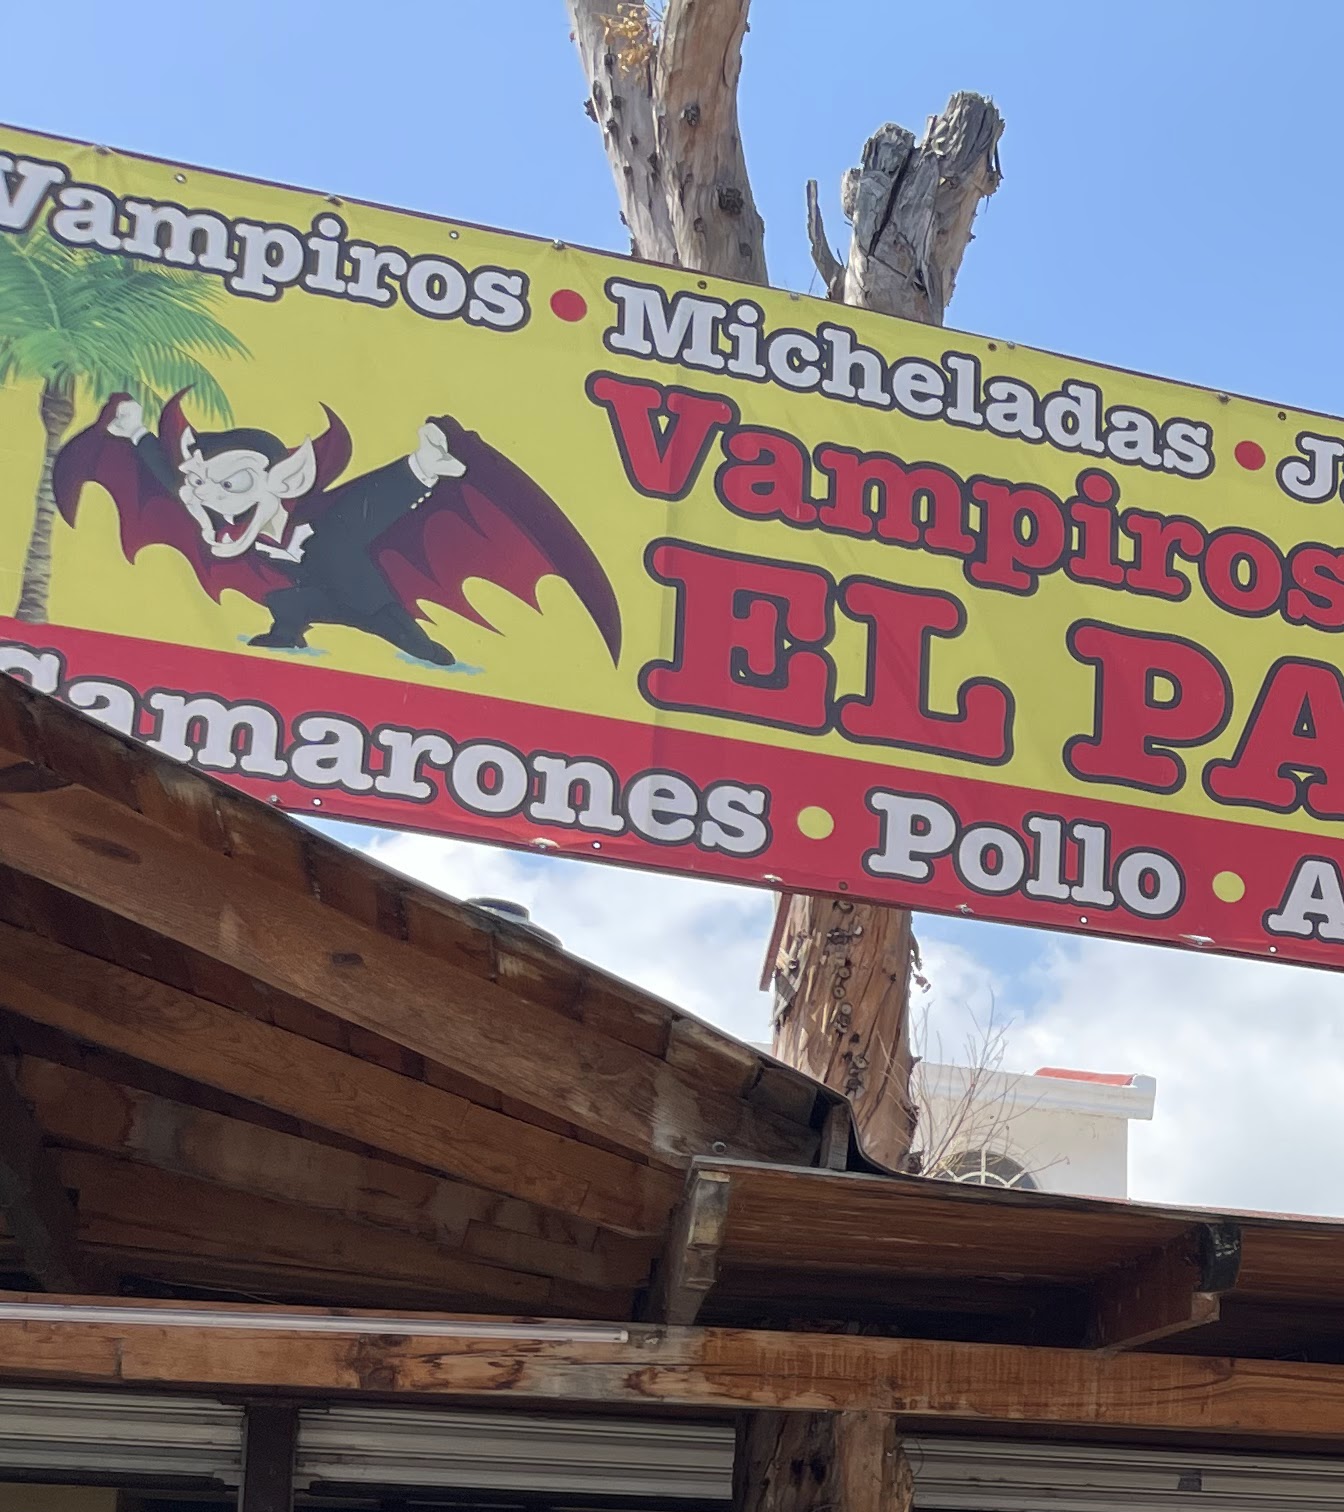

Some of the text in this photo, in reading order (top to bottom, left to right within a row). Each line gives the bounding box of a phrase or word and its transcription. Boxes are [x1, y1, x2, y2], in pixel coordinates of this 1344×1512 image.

[0, 153, 529, 331] Vampiros
[606, 278, 1213, 479] Micheladas
[638, 537, 1014, 767] EL
[863, 788, 1187, 922] Pollo
